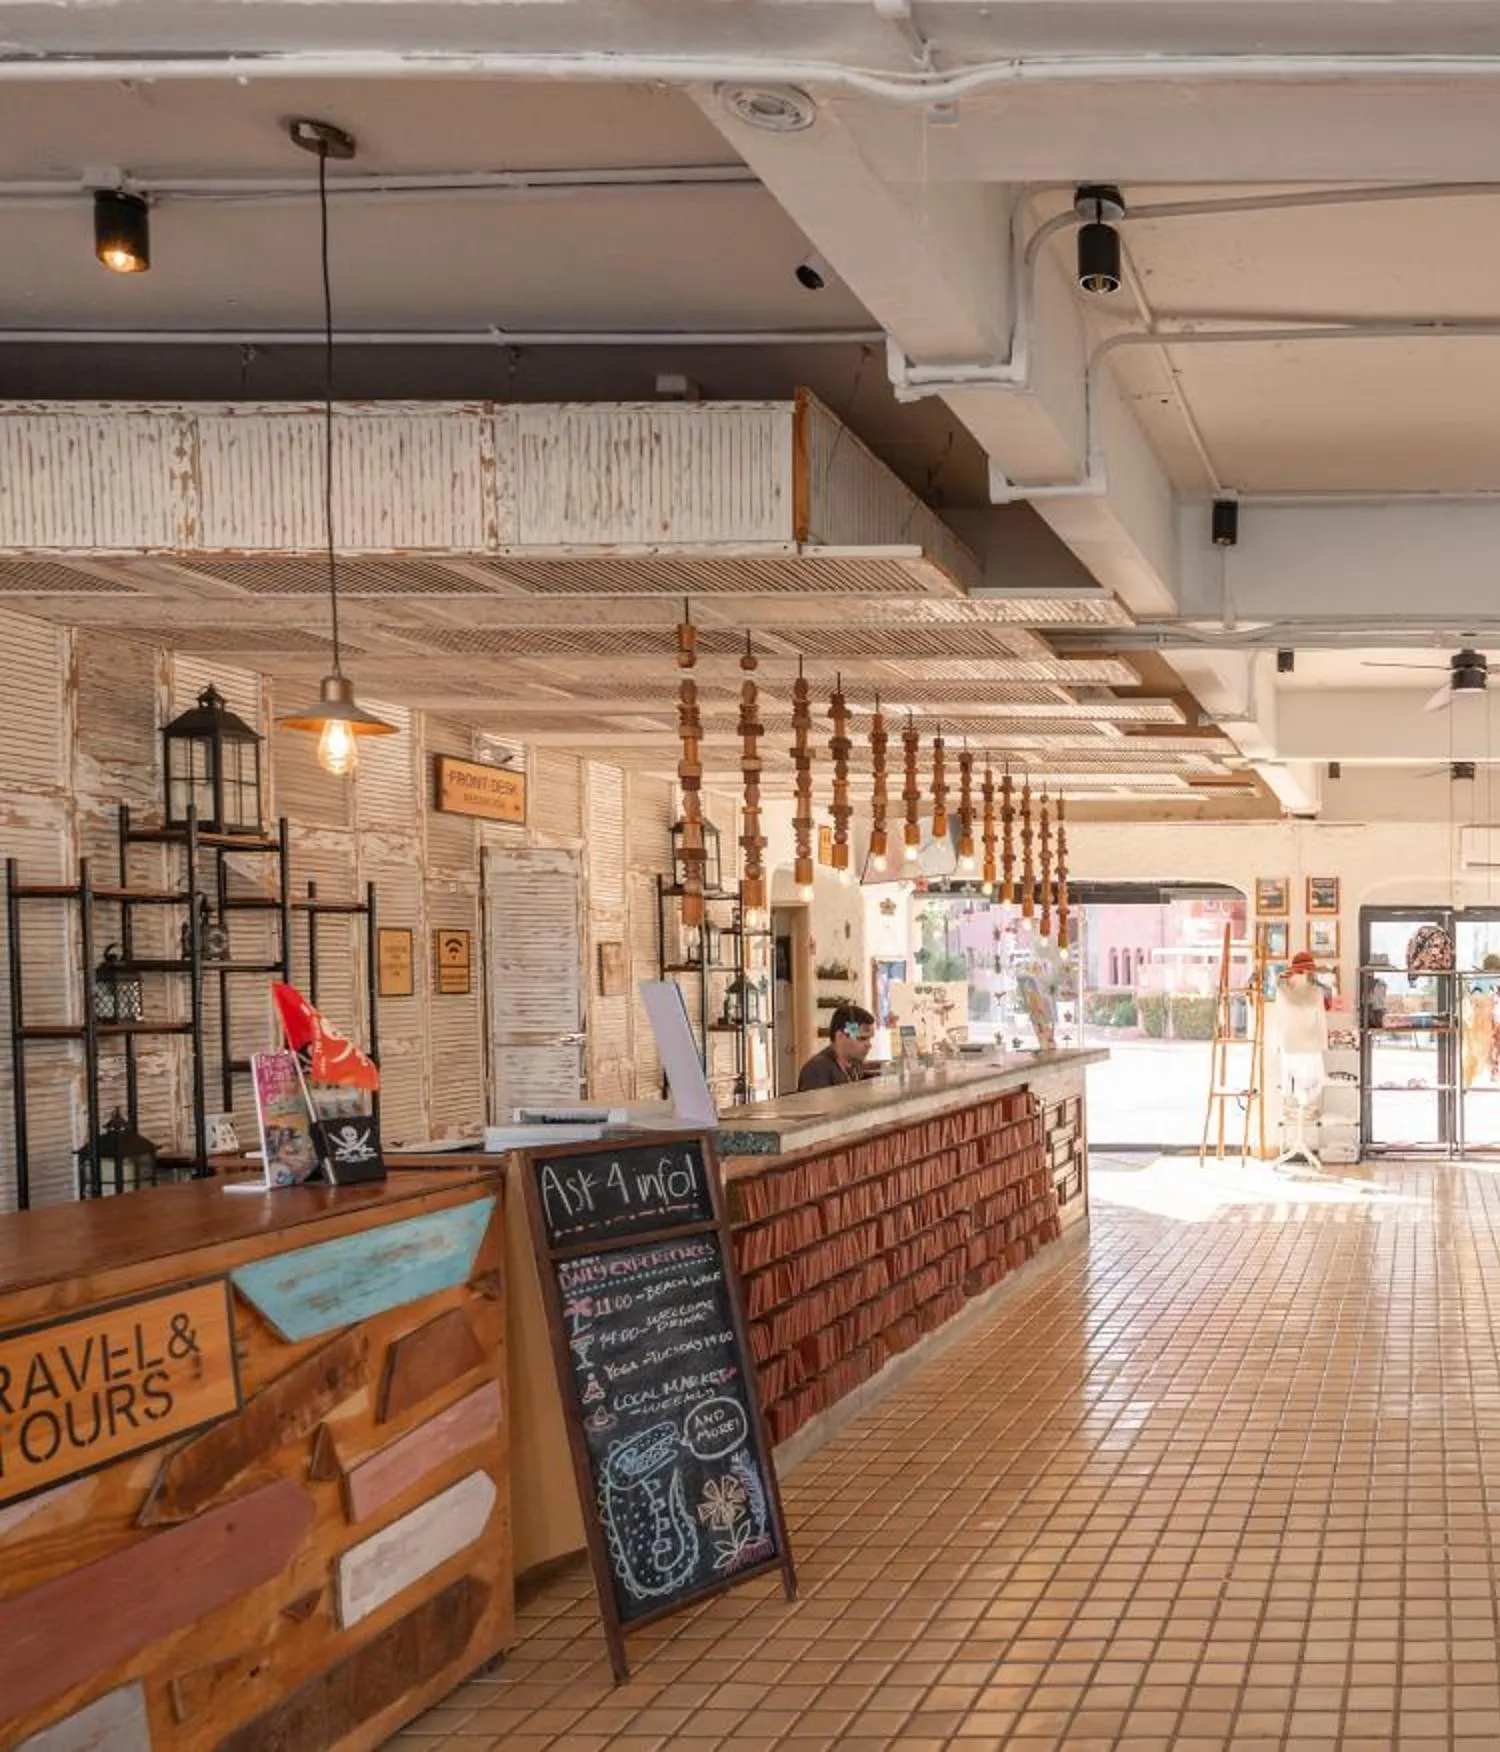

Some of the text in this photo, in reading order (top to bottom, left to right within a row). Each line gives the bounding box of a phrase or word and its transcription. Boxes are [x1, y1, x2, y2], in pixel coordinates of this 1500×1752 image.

[606, 1161, 631, 1204] 4
[632, 1153, 698, 1206] info!
[643, 1277, 689, 1301] BEACH
[613, 1367, 726, 1411] LOCAL MARKET
[0, 1369, 174, 1477] OURS
[694, 1408, 726, 1429] AND
